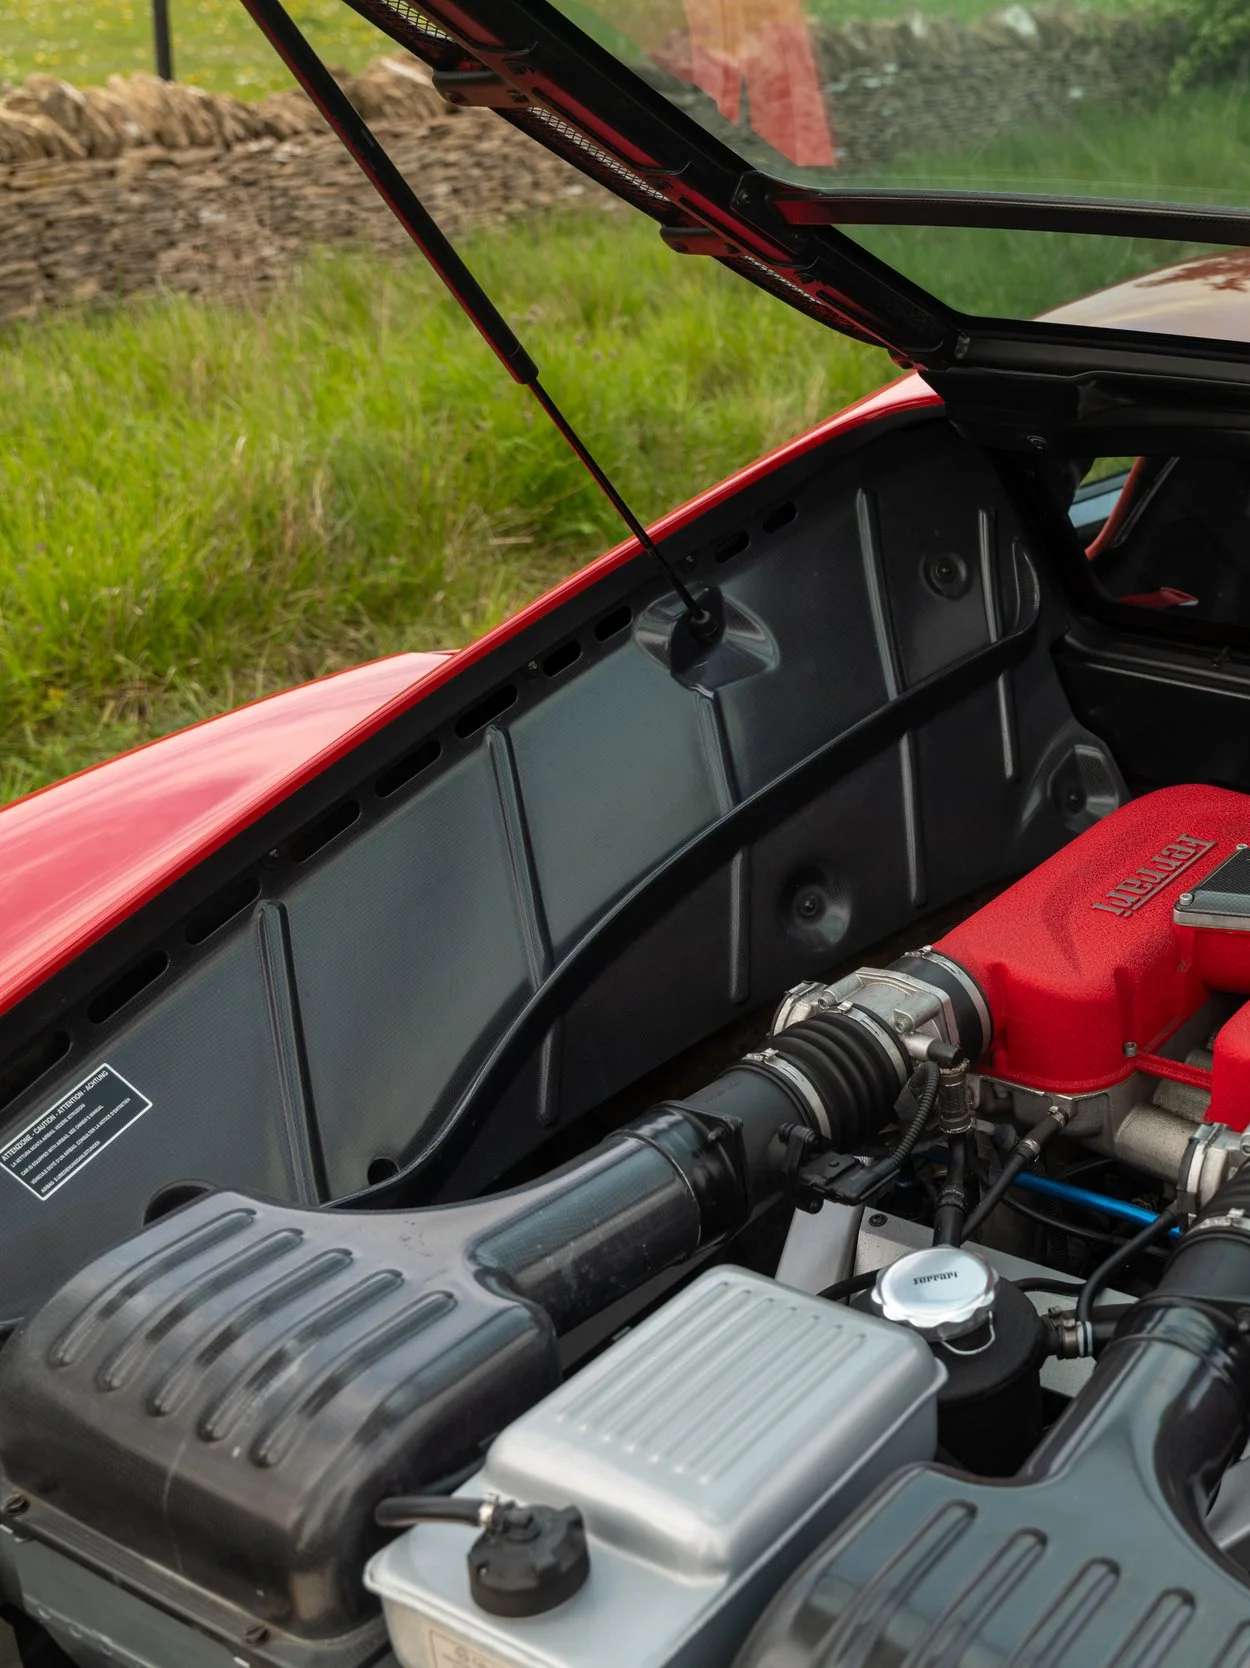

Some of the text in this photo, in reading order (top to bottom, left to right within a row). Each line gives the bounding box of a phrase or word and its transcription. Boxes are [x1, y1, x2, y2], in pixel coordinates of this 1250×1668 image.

[1092, 833, 1217, 918] Ferrari
[1, 1133, 33, 1161] ATTENZIONE
[33, 1114, 56, 1134] CAUTION
[57, 1090, 84, 1114] ATTENTION
[84, 1070, 108, 1091] ACHTUNG
[98, 1113, 112, 1125] NOTICE
[15, 1149, 32, 1163] VETTURA
[29, 1139, 43, 1151] MONTA
[54, 1117, 69, 1130] VEDERE
[20, 1167, 30, 1176] CAR
[31, 1151, 49, 1167] EQUIPPED
[47, 1144, 57, 1153] WITH
[68, 1127, 77, 1135] SEE
[914, 1271, 958, 1285] Ferrari
